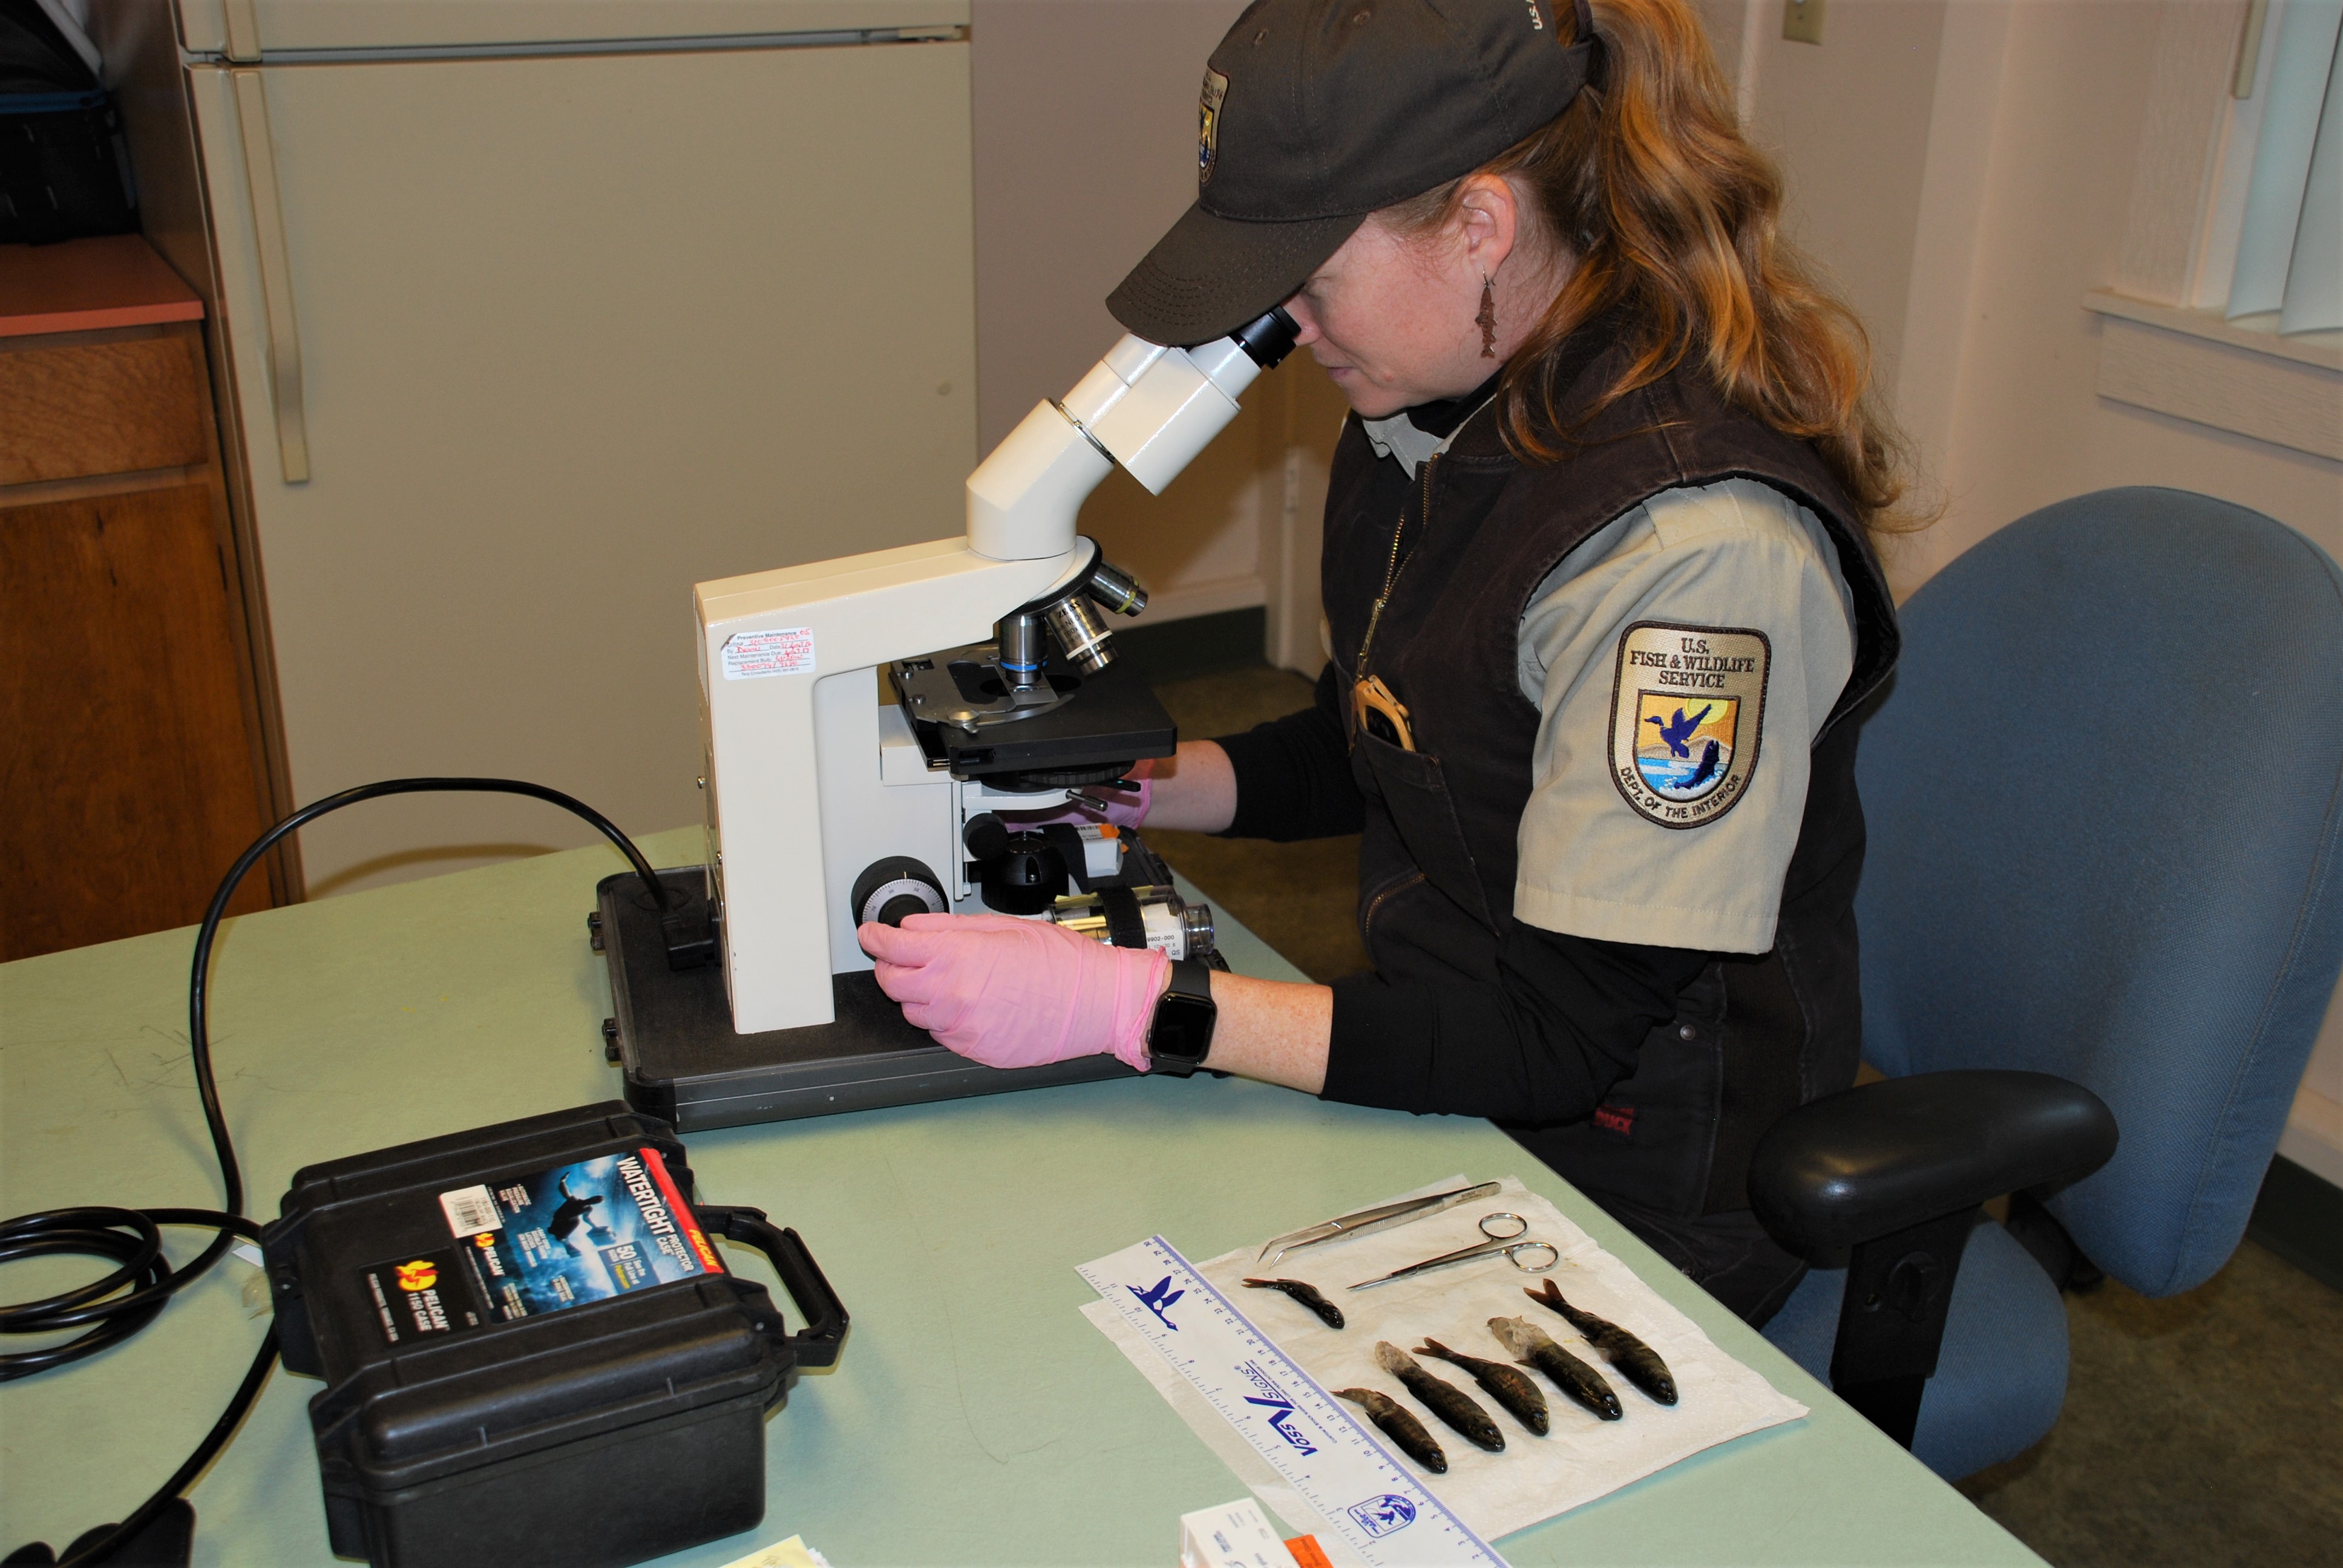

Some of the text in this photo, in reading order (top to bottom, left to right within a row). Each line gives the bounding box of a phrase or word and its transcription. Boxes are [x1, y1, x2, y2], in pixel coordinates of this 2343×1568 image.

[1057, 600, 1081, 619] ZEISS
[1681, 637, 1709, 654] U.S.
[1630, 650, 1754, 673] FISH & WILDLIFE
[1659, 670, 1725, 688] SERVICE
[1620, 766, 1742, 818] DEPT. OF THE INTERIOR
[617, 1156, 694, 1272] WATERTIGHT PROTECTOR
[482, 1246, 505, 1276] PELICAN
[616, 1245, 637, 1260] 50
[689, 1229, 718, 1267] PELICAN
[406, 1292, 432, 1331] 1150 CASE
[420, 1289, 449, 1330] PELICAN
[1280, 1424, 1318, 1456] VOSS
